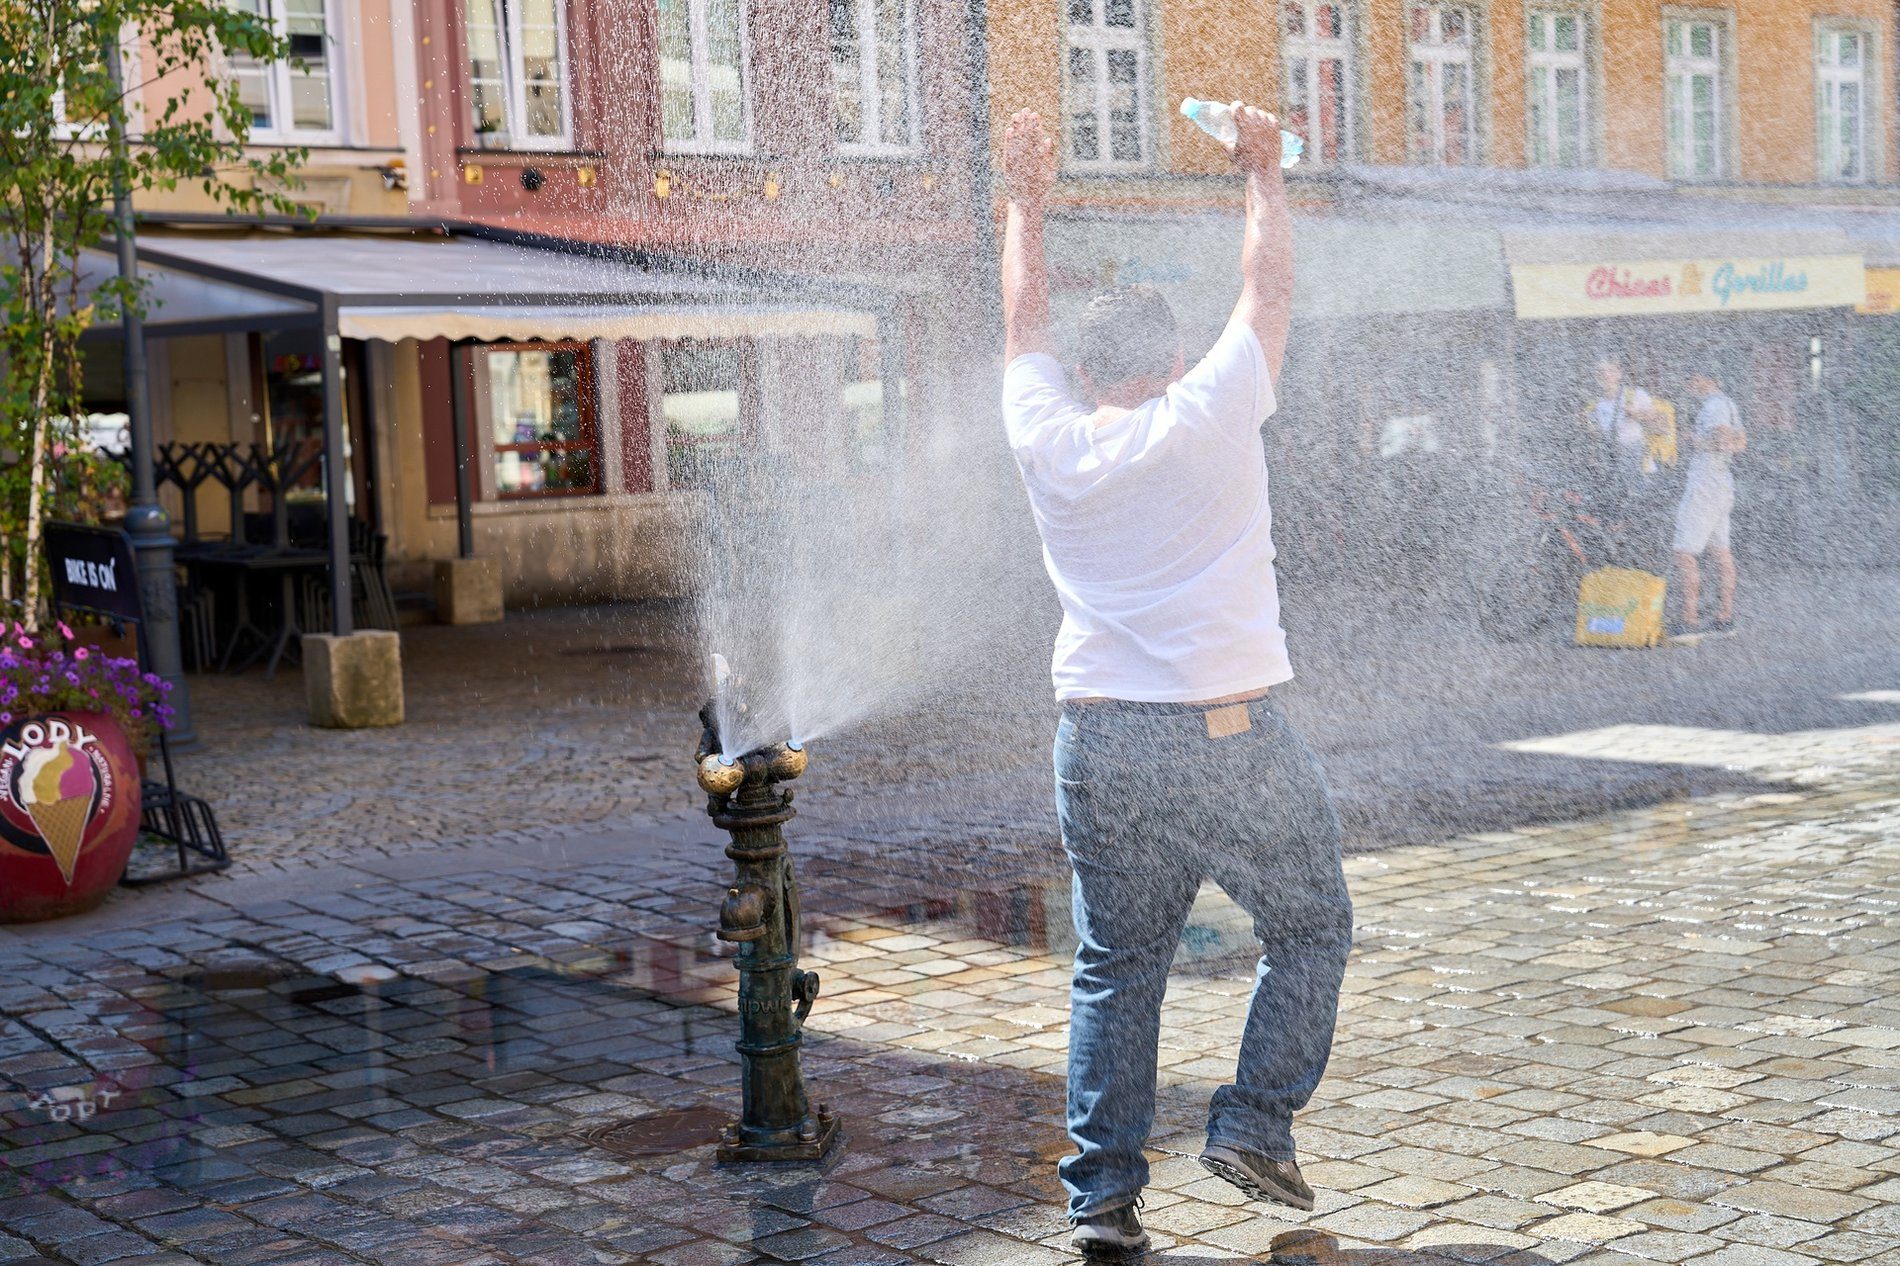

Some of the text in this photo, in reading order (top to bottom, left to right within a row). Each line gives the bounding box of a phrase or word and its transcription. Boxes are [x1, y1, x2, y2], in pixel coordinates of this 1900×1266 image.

[1712, 262, 1808, 307] Gorillas
[65, 557, 89, 586] BIKE
[87, 561, 99, 588] IS
[1, 720, 98, 761] LODY
